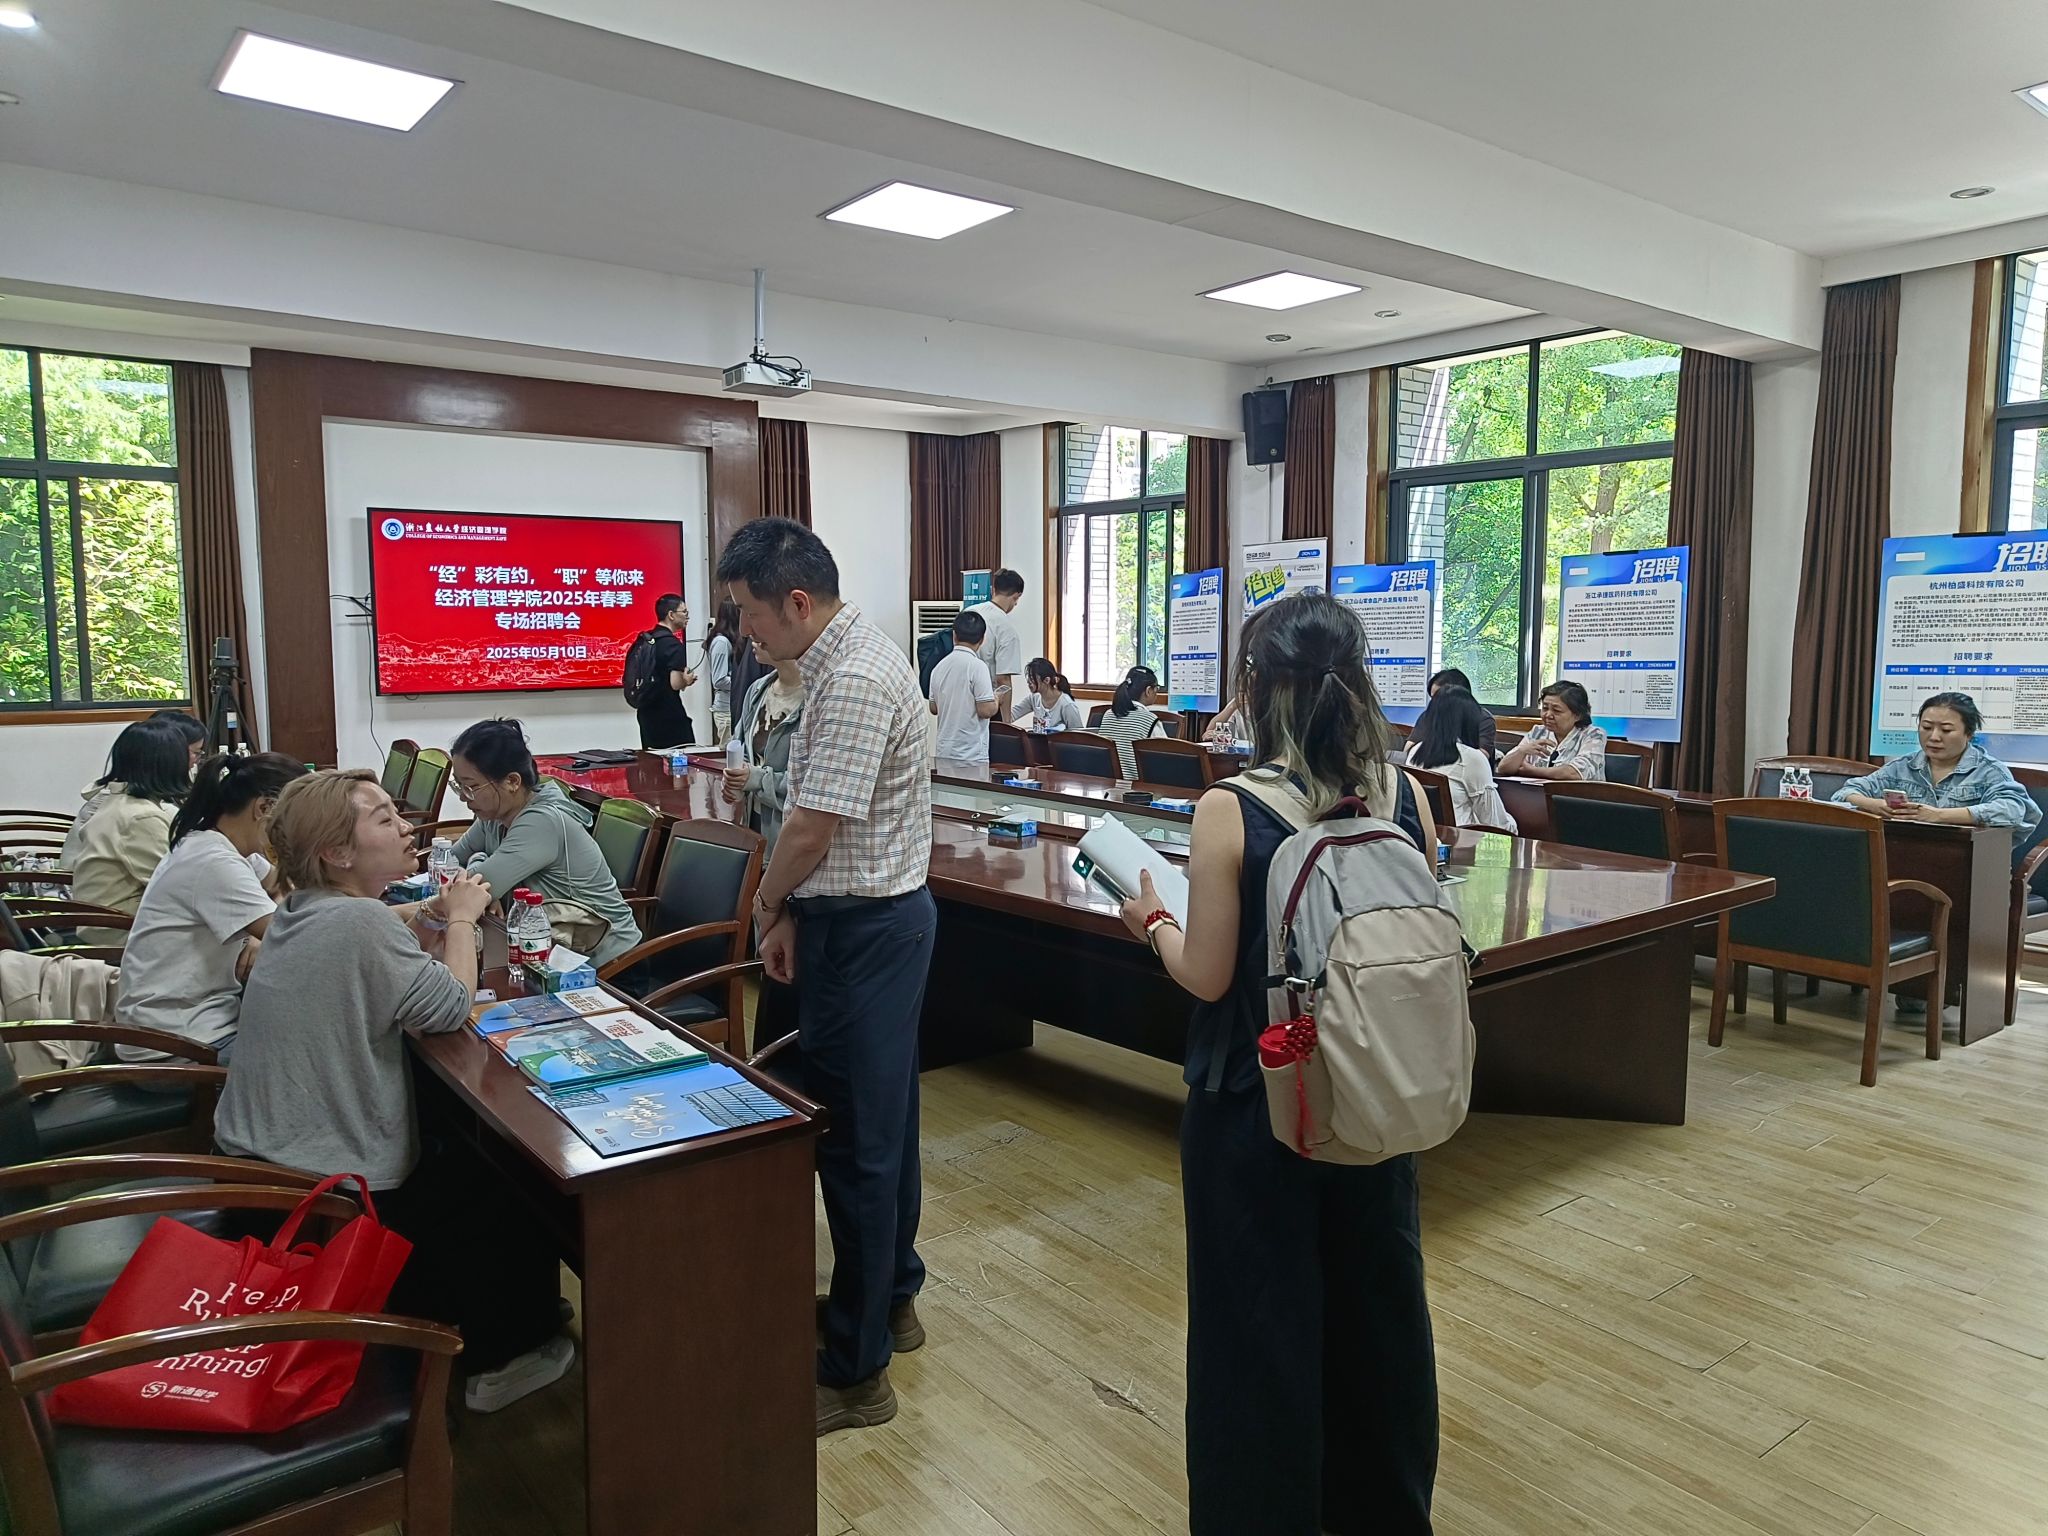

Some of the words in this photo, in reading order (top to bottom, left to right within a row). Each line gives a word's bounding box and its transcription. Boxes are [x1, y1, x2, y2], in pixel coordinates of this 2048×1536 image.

[1388, 568, 1428, 592] 招聘
[1631, 556, 1680, 584] 招聘
[1198, 575, 1219, 597] 招聘
[1244, 564, 1285, 604] 招聘
[434, 588, 633, 608] 经济管理学院2025年春季
[495, 612, 581, 630] 专场招聘会
[486, 646, 587, 659] 2025年05月10日
[1953, 652, 1993, 661] 招聘要求
